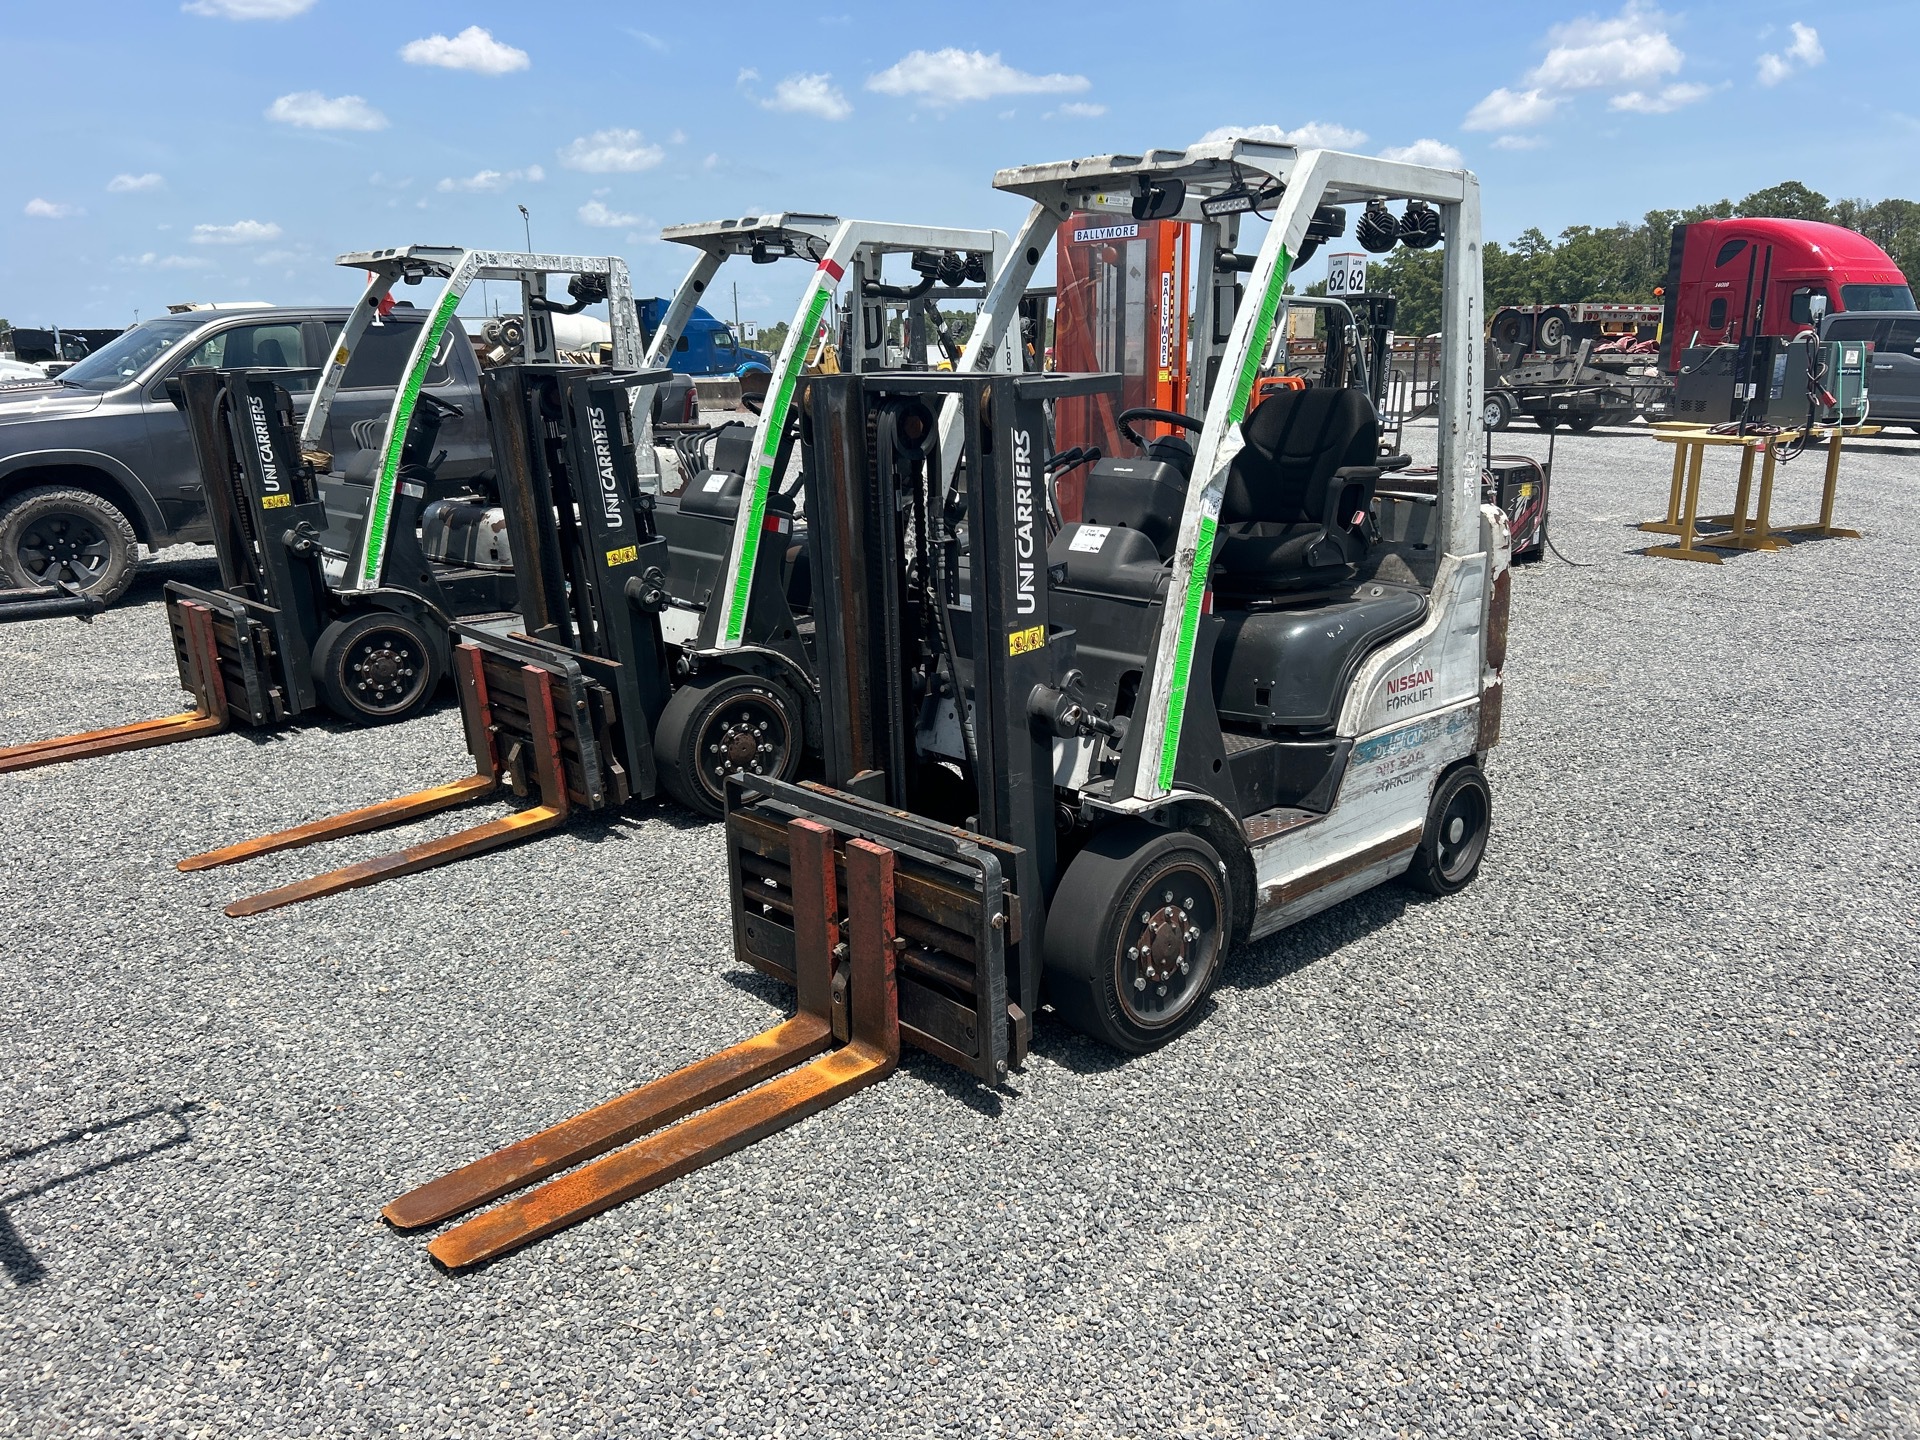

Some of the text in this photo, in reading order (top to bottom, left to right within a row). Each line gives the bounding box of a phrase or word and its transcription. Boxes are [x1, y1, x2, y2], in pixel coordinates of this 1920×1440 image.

[1077, 225, 1135, 241] BALLYMORE
[1329, 269, 1345, 291] 62
[1350, 269, 1364, 291] 62
[748, 328, 753, 337] J
[1161, 277, 1169, 364] BALLYMORE
[625, 327, 633, 368] FL8
[1466, 297, 1474, 430] FL8657
[1381, 352, 1391, 395] TOYOTA
[247, 395, 280, 492] UNICARRIERS
[586, 406, 623, 528] UNICARRIERS
[1011, 427, 1035, 614] UNICARRIERS
[1386, 687, 1434, 712] FORKLIFT
[1387, 669, 1434, 695] NISSAN
